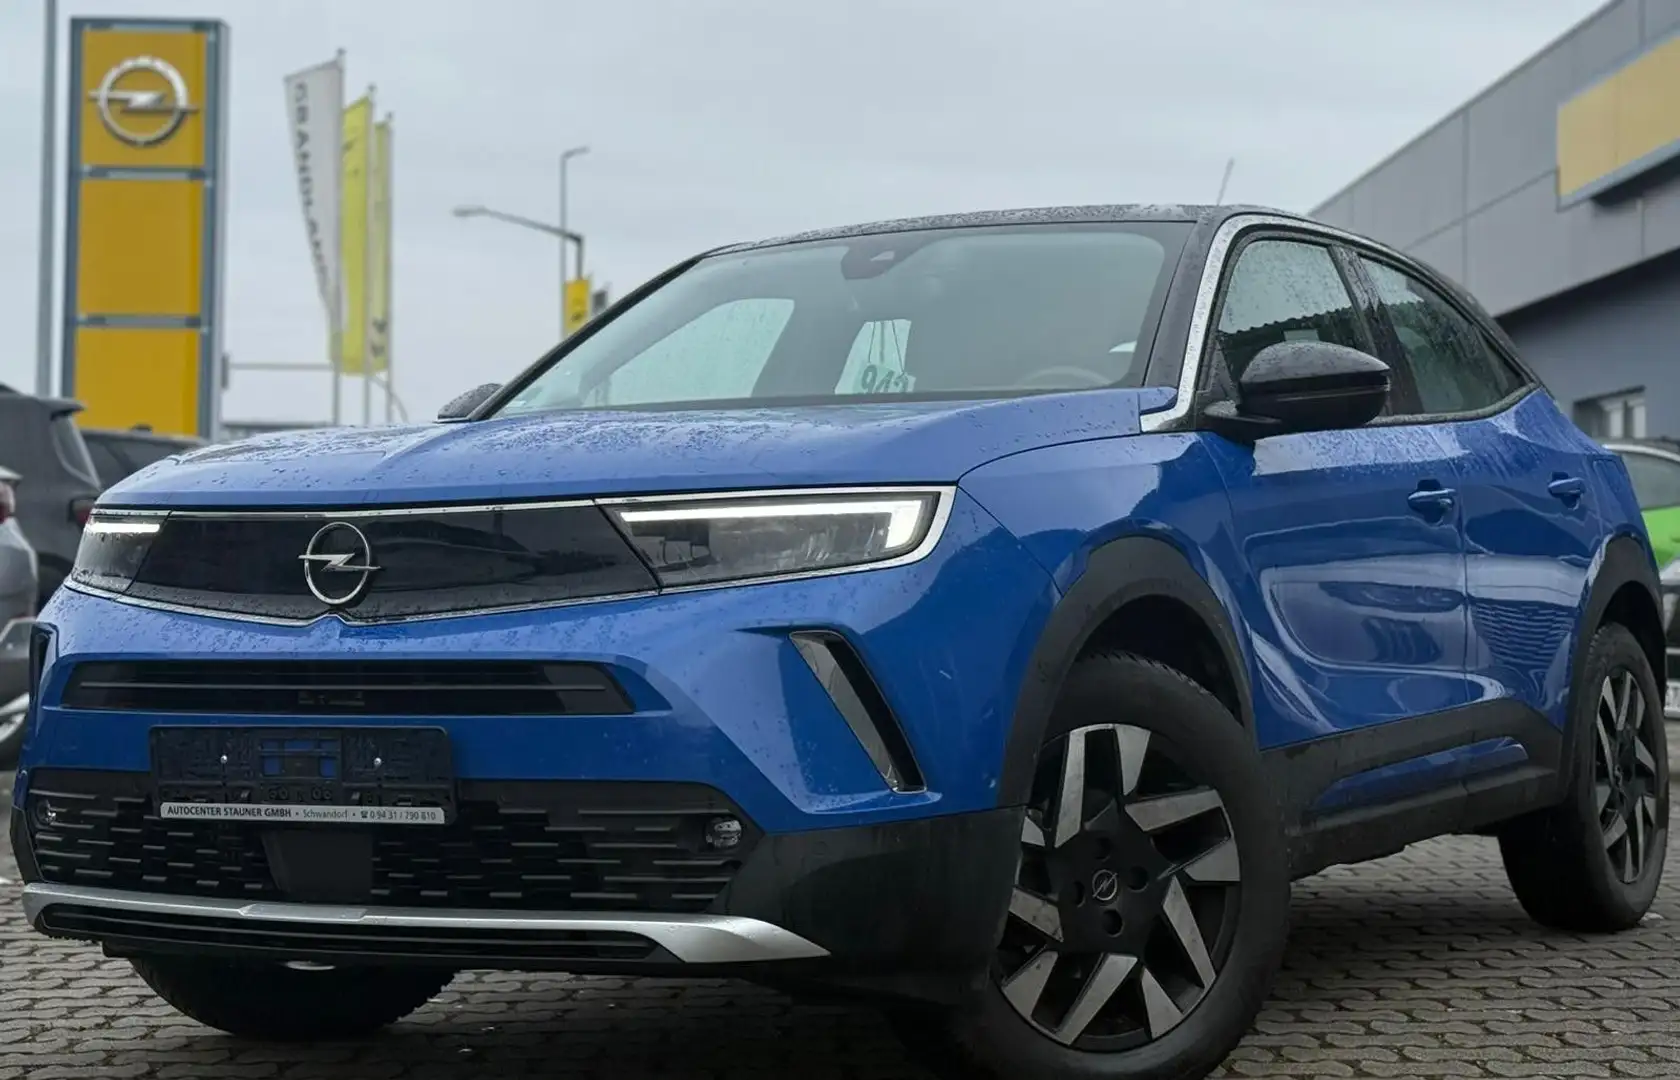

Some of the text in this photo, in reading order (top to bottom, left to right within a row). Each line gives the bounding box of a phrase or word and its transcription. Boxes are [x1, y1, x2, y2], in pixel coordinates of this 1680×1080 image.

[167, 805, 221, 816] AUTOCENTER
[223, 806, 262, 817] STAUNER
[264, 807, 292, 818] GMBH
[303, 809, 348, 819] Schwandorf
